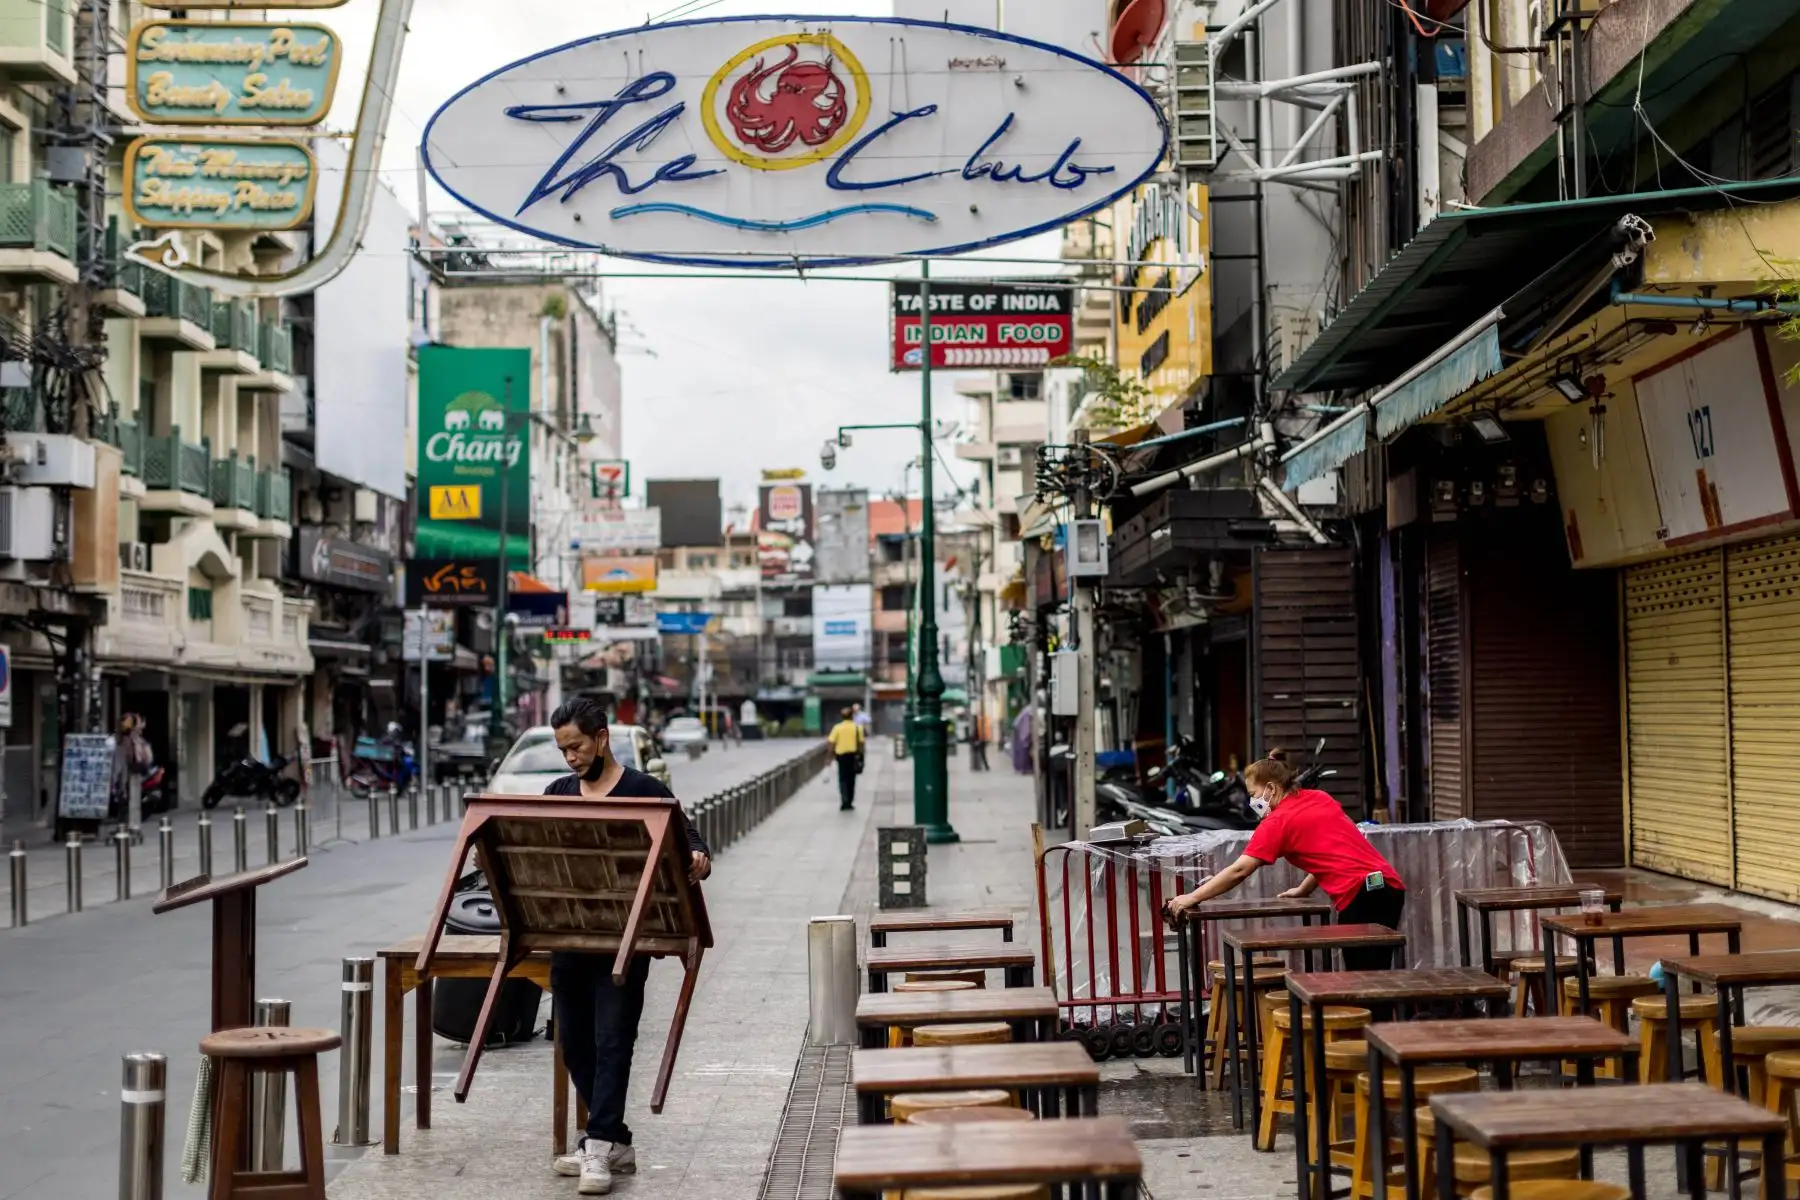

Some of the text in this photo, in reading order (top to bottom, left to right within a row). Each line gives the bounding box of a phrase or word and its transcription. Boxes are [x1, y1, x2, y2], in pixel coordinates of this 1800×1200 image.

[503, 71, 1116, 217] The Club
[898, 293, 1061, 311] TASTE OF INDIA
[998, 323, 1063, 343] FOOD
[425, 432, 522, 468] Chang
[1687, 405, 1715, 460] 127
